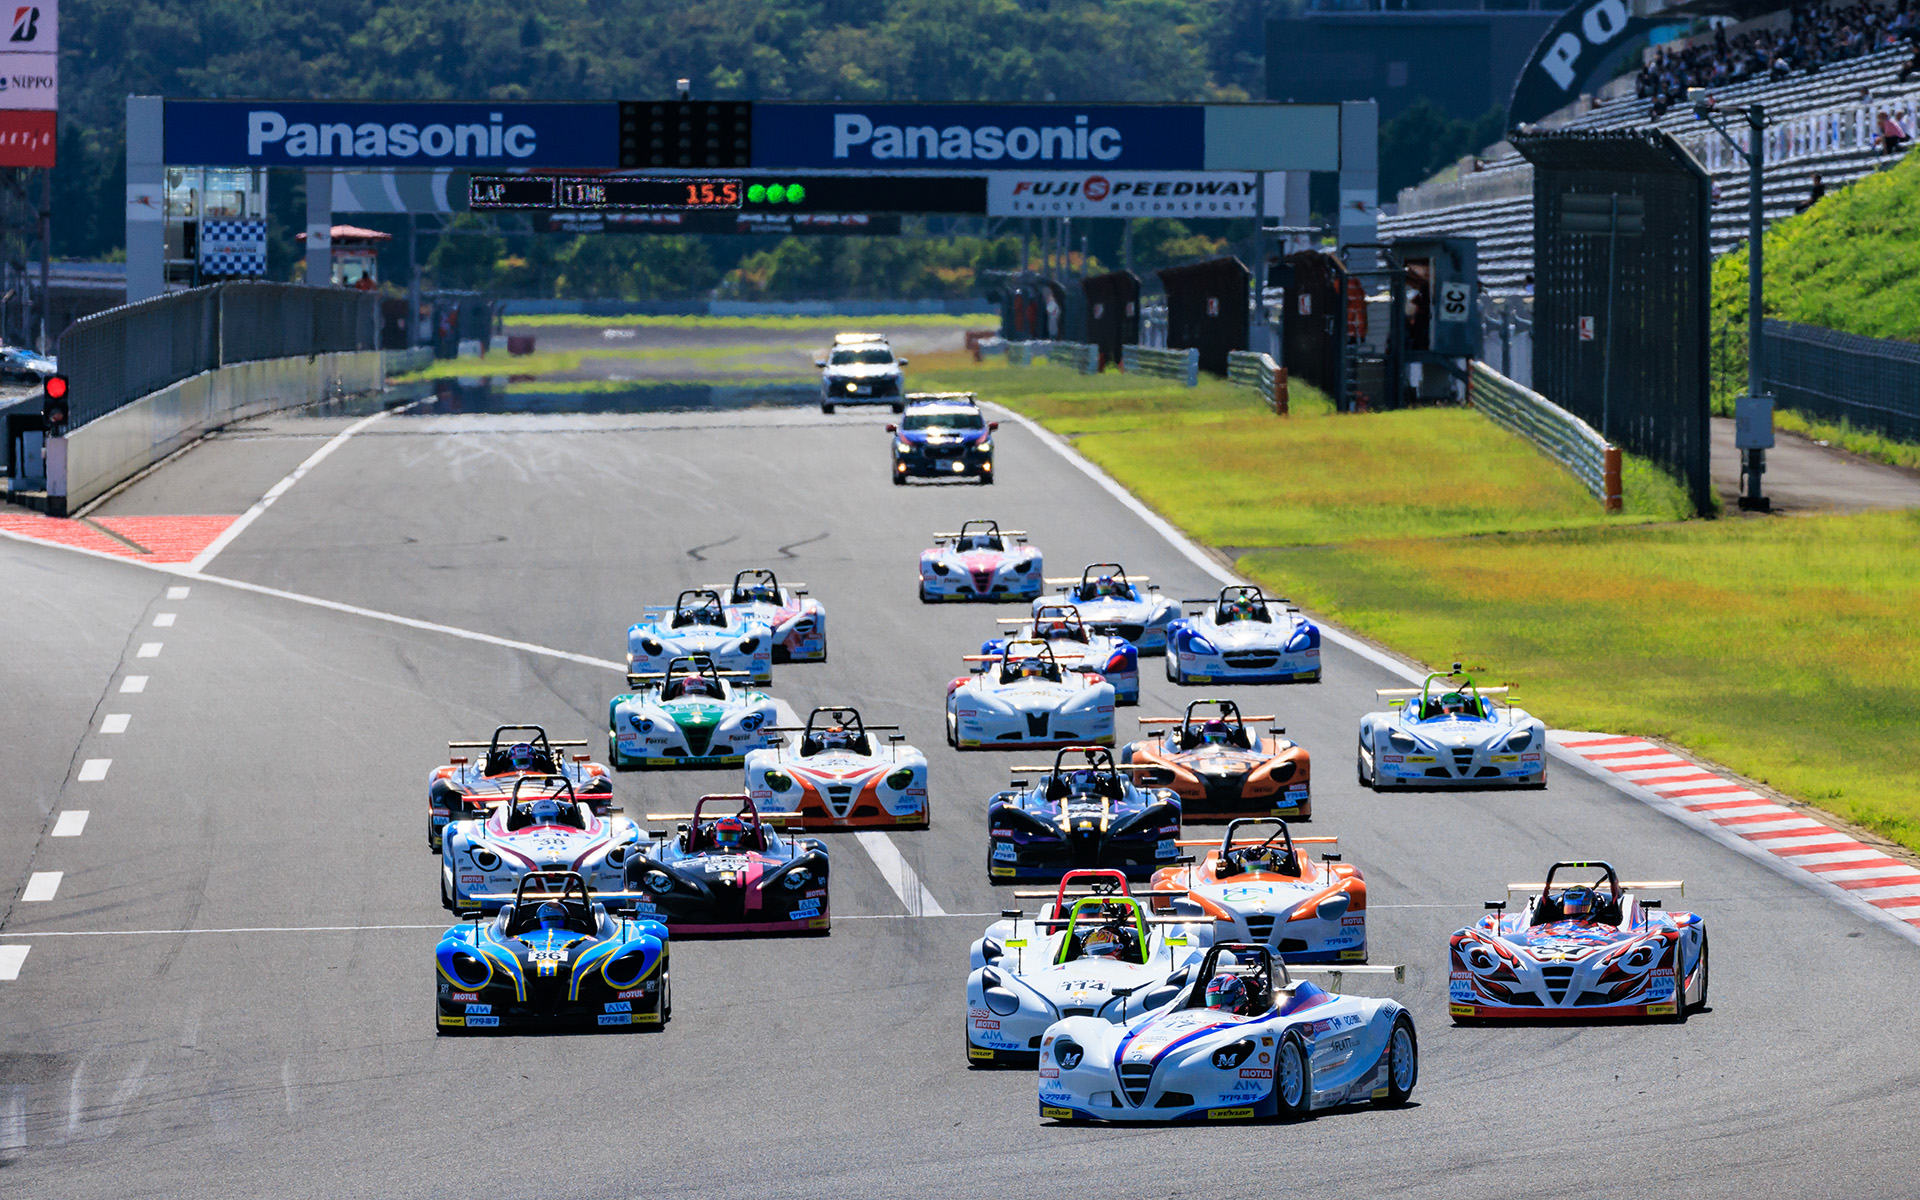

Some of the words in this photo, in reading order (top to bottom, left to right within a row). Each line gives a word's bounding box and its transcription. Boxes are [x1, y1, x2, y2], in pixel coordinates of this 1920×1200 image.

[12, 75, 53, 88] NIPPO
[248, 112, 537, 158] Panasonic
[834, 113, 1123, 160] Panasonic
[474, 184, 506, 201] LAP
[1012, 181, 1081, 196] FUJI
[1083, 175, 1257, 201] SPEEDWAY
[686, 184, 737, 204] 15.5
[1446, 290, 1465, 314] SC
[467, 883, 488, 891] AIM
[806, 890, 826, 898] MOTUL
[535, 952, 561, 960] 86
[1650, 969, 1674, 977] MOTUL
[1061, 982, 1106, 991] 114
[1450, 980, 1470, 989] AIM
[1653, 977, 1675, 987] AIM
[453, 993, 478, 1001] MOTUL
[618, 991, 643, 999] MOTUL
[466, 1005, 489, 1013] AIM
[607, 1003, 631, 1011] AIM
[970, 1009, 990, 1019] BBS
[981, 1031, 1003, 1040] AIM
[1045, 1080, 1062, 1089] AIM
[1233, 1081, 1262, 1090] AIM
